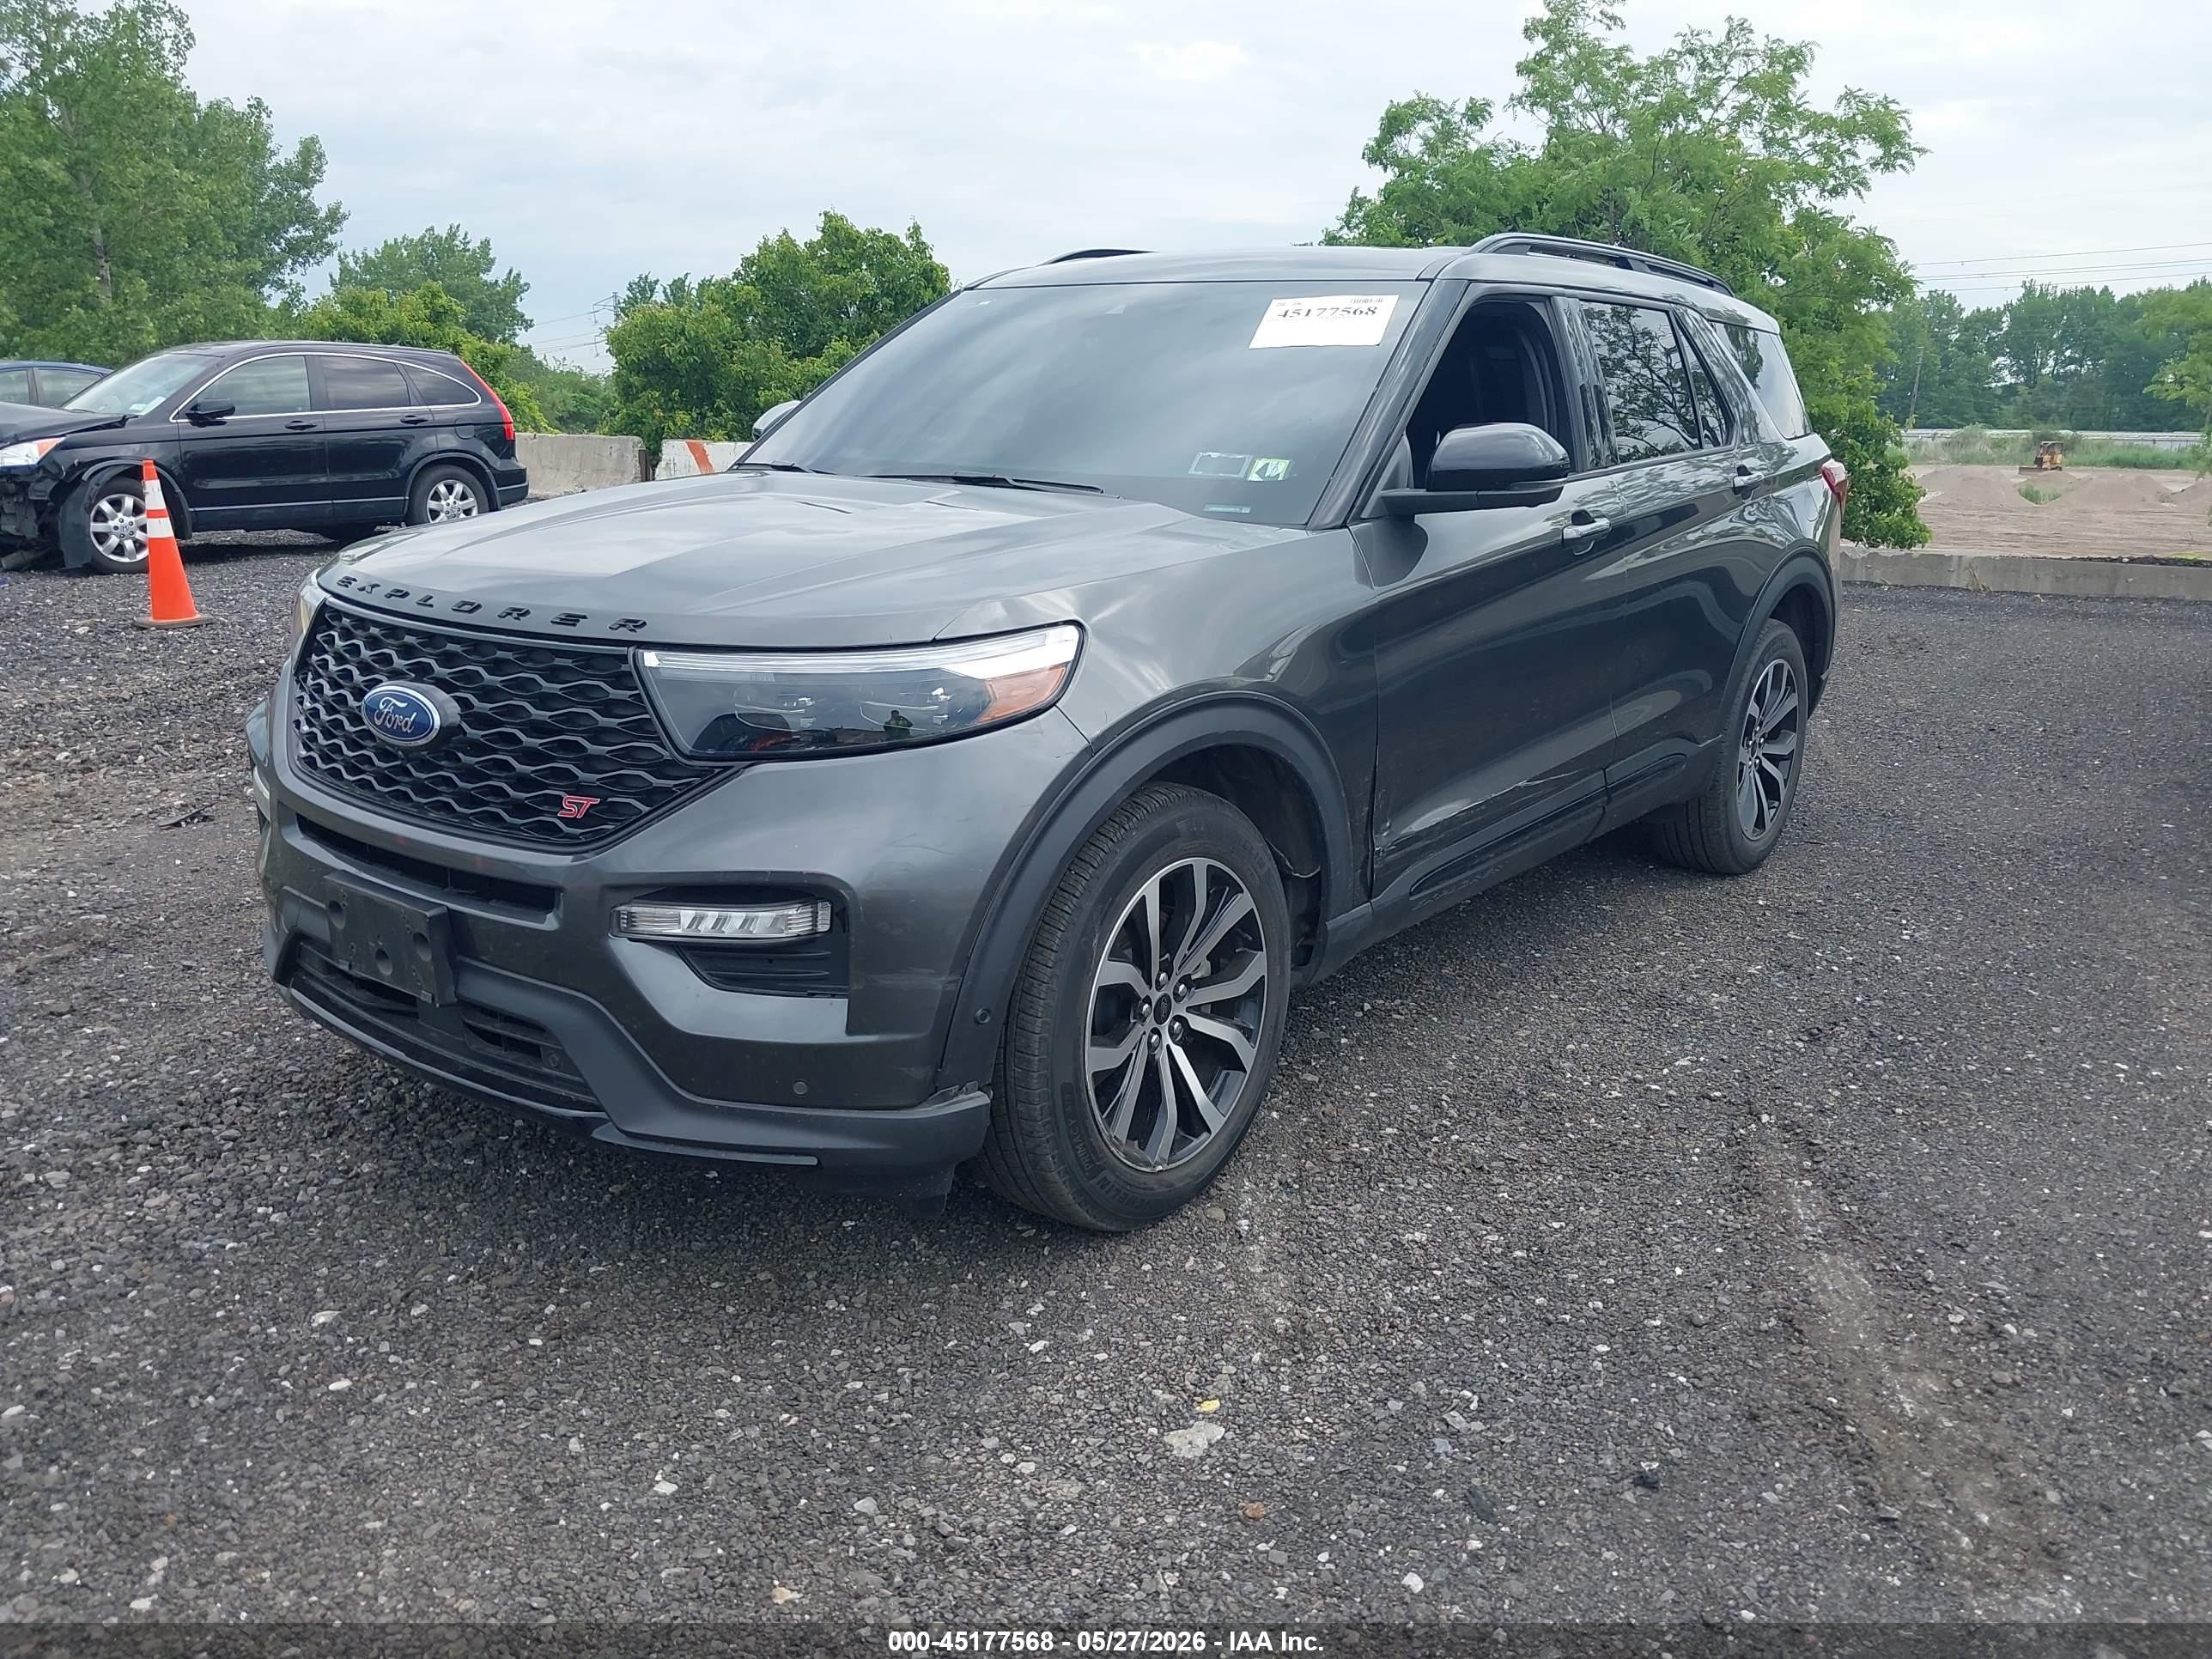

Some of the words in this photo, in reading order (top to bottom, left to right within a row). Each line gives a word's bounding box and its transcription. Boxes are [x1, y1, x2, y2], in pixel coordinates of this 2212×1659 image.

[1277, 306, 1378, 318] 45177568
[336, 575, 647, 634] EXPLORER
[374, 696, 417, 733] Ford
[557, 795, 600, 819] ST
